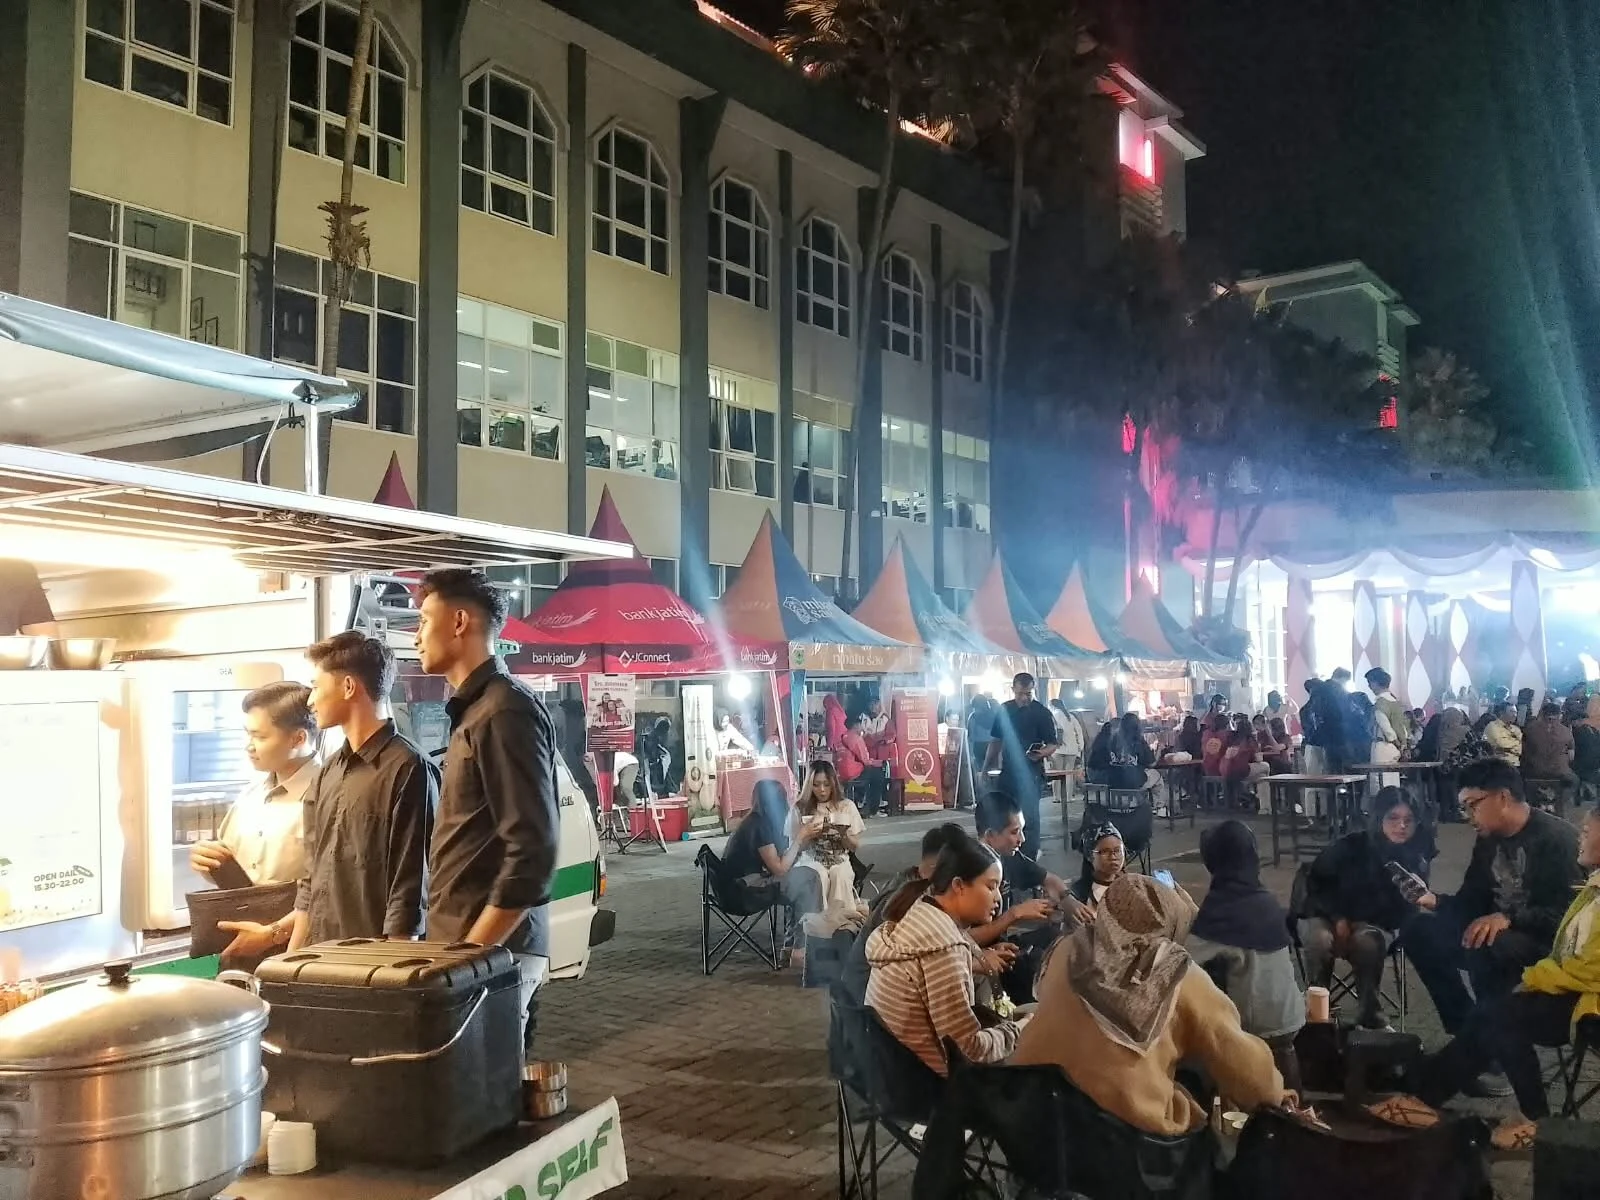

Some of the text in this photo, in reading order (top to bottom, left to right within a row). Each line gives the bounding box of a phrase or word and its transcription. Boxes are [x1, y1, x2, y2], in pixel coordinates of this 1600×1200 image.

[532, 651, 575, 666] bankjatim
[634, 652, 671, 663] JConnect
[34, 873, 56, 882] OPEN
[538, 1117, 613, 1200] SELF
